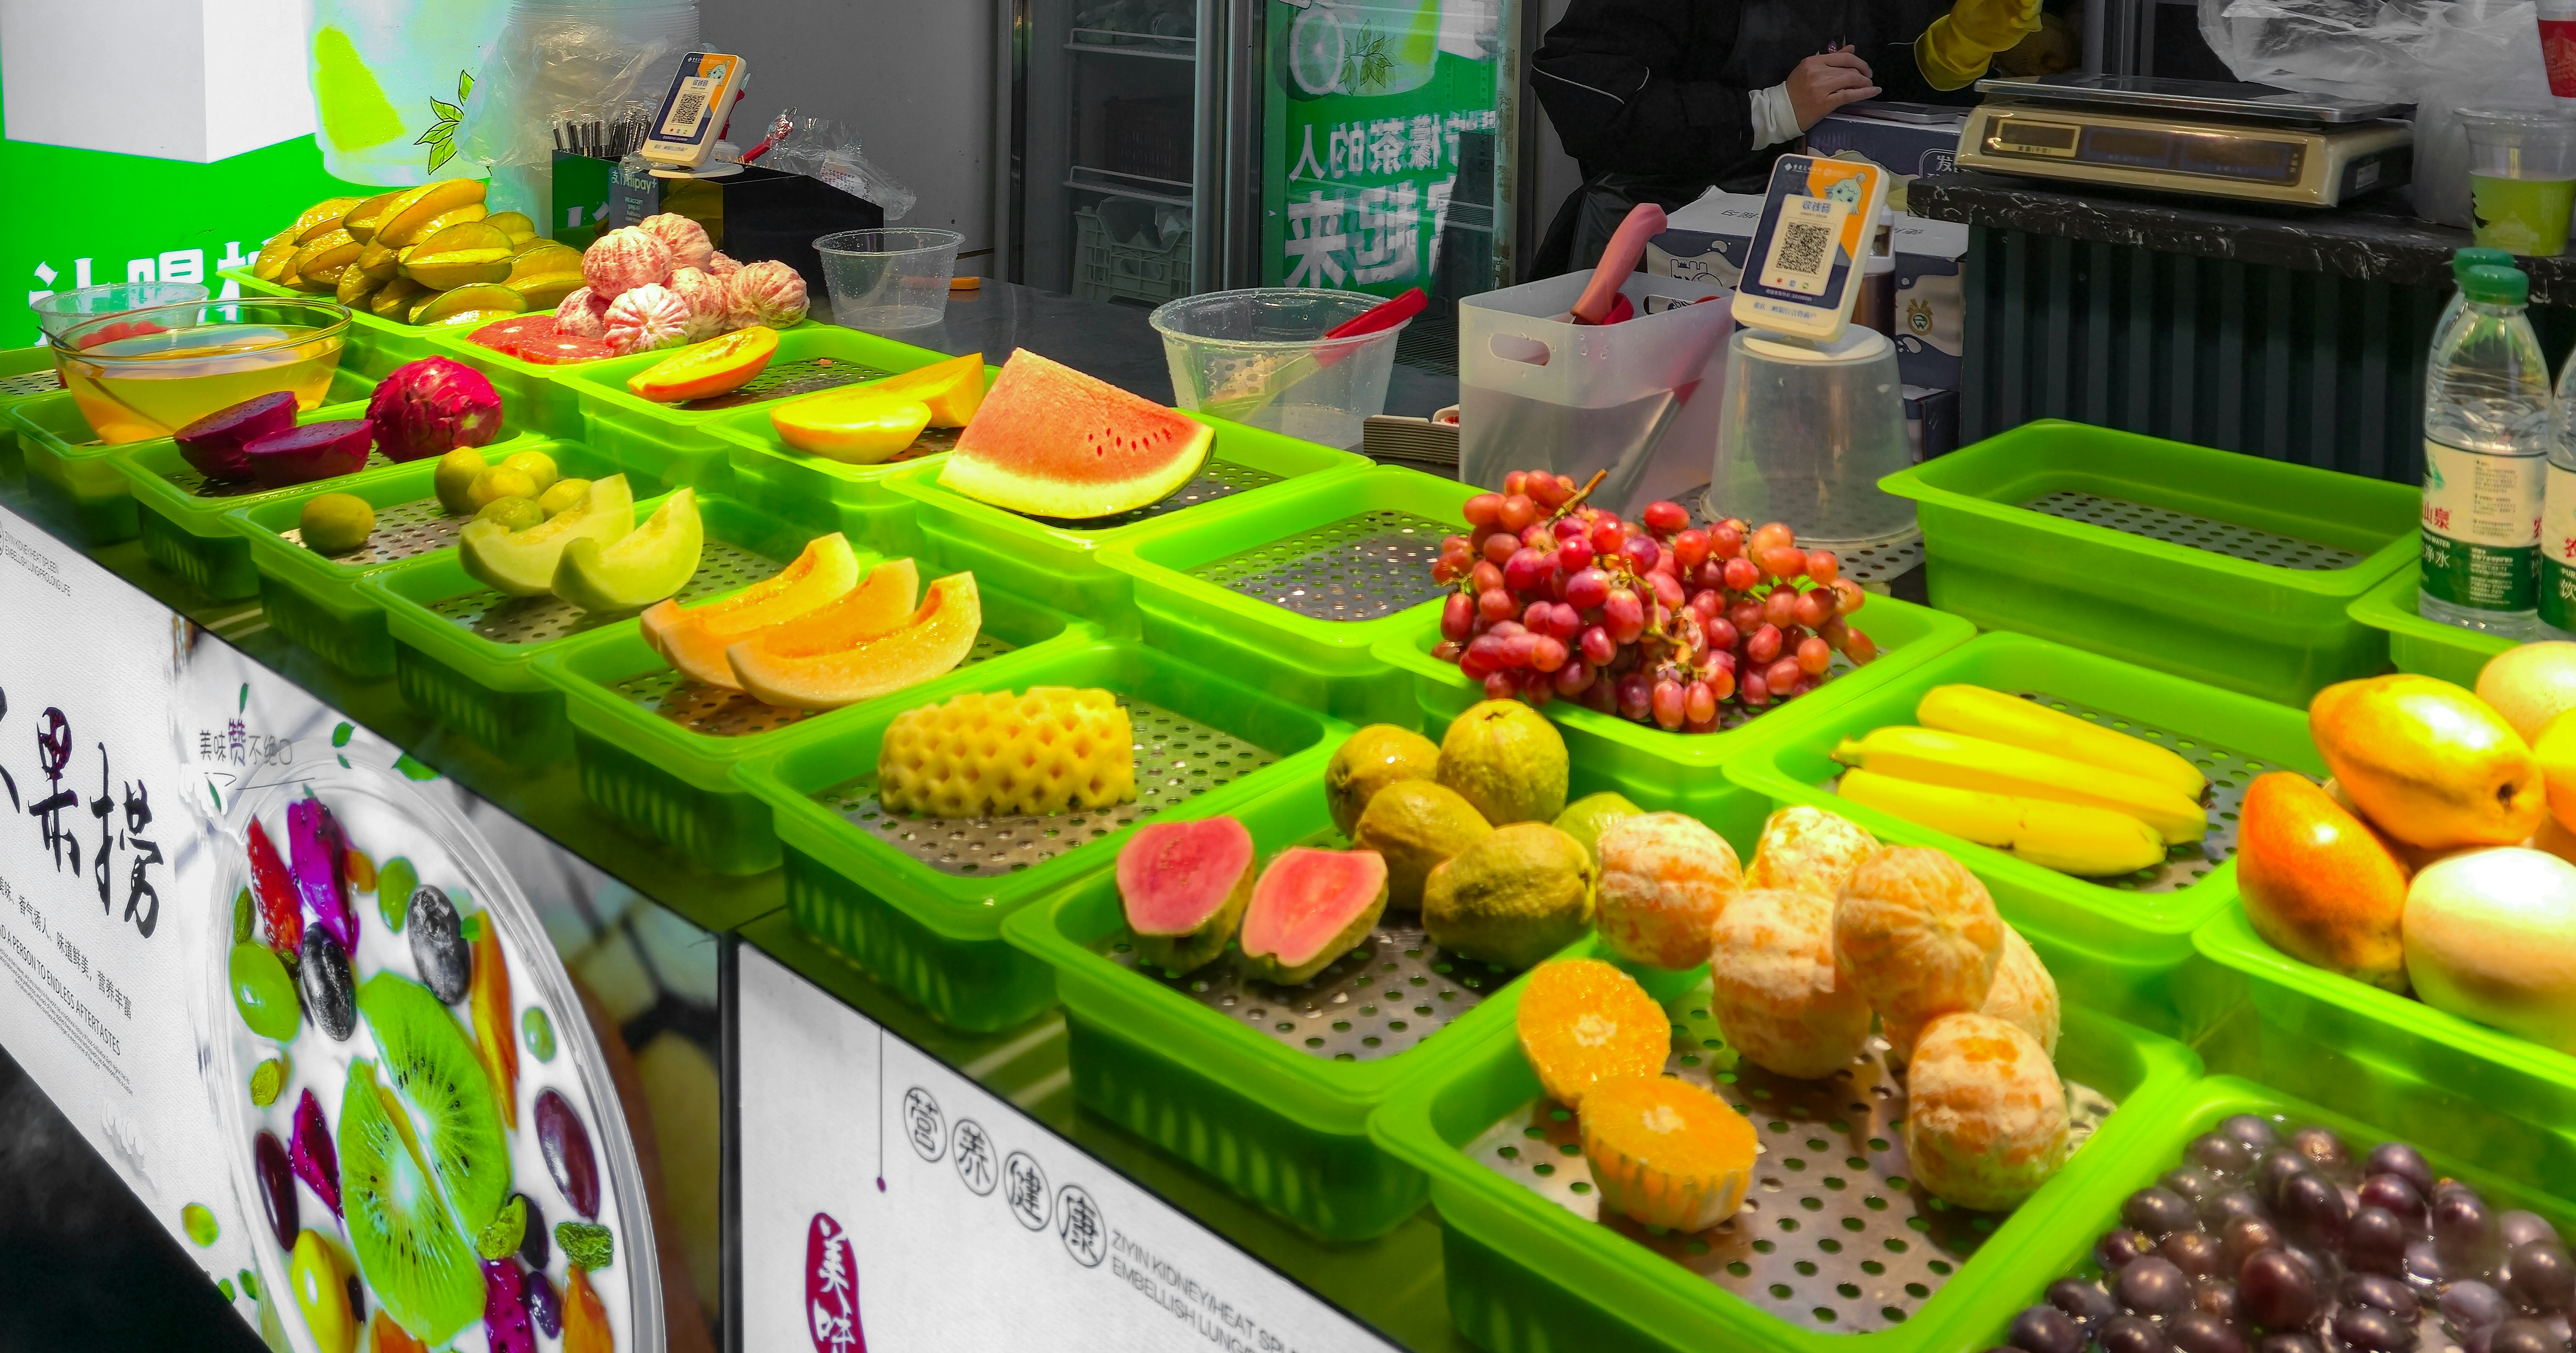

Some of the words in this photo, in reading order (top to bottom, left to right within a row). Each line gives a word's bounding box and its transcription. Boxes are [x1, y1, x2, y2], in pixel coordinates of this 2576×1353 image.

[8, 931, 12, 946] A
[13, 936, 36, 971] PERSON
[37, 960, 45, 980] TO
[47, 970, 75, 1009] ENDLESS
[76, 1000, 120, 1056] AFTERTASTES
[1112, 1229, 1149, 1270] ZIYIN
[1112, 1256, 1196, 1327] EMBELLISH
